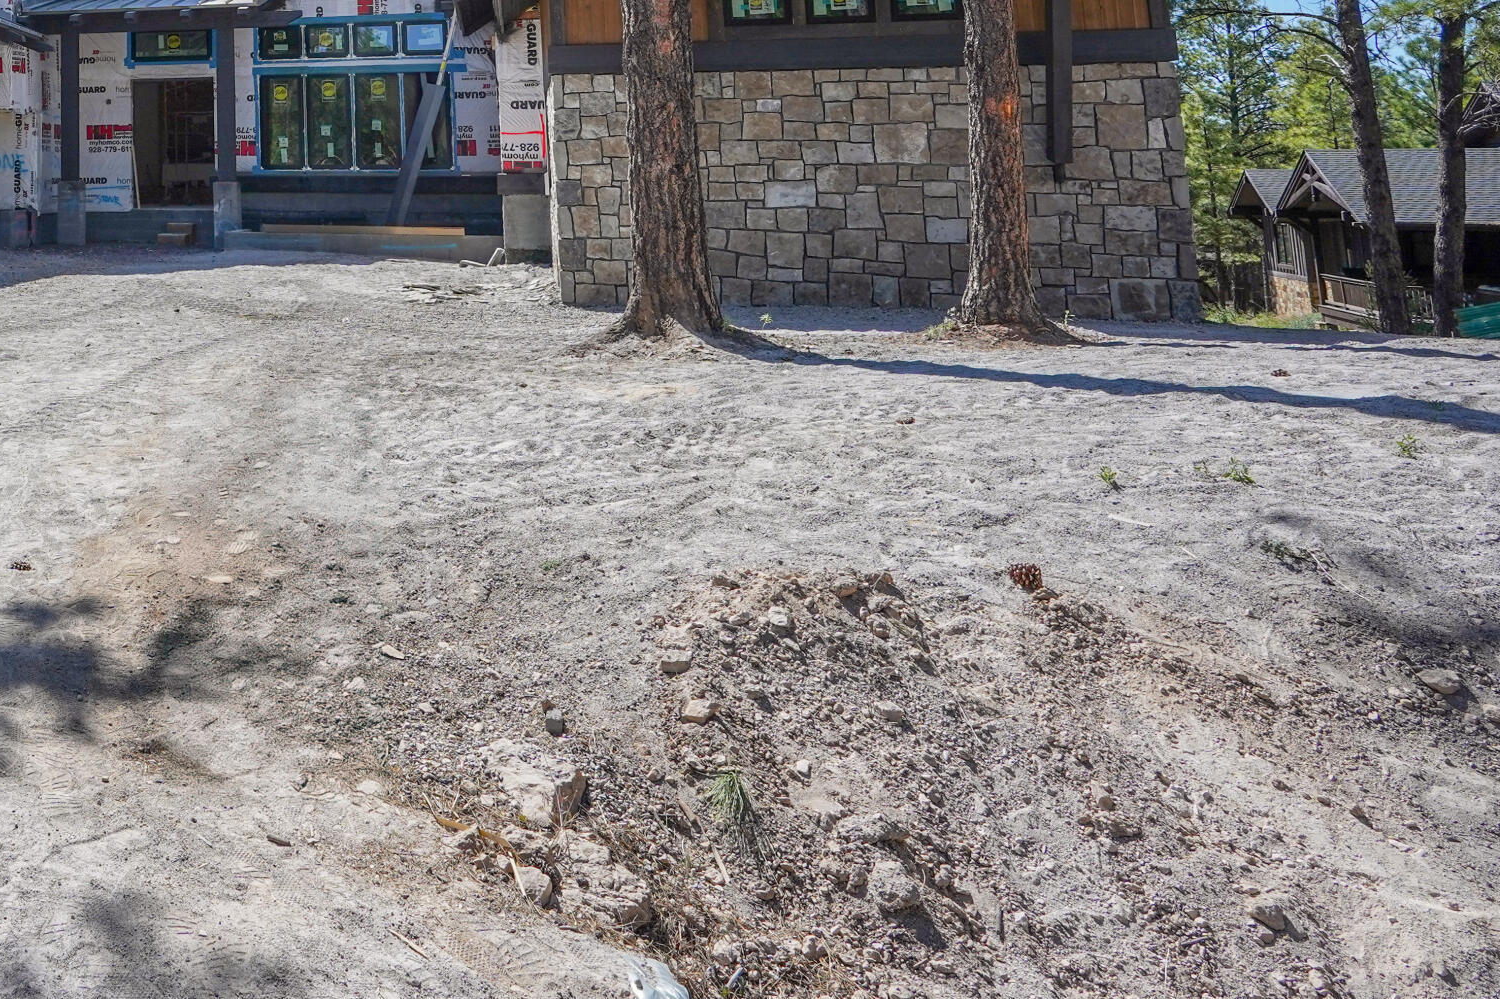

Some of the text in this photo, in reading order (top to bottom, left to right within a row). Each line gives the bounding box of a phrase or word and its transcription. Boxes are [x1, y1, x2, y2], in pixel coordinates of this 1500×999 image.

[79, 55, 116, 65] homeGUA
[77, 85, 106, 93] GUARD
[14, 113, 23, 149] homeGU
[458, 125, 473, 133] 928
